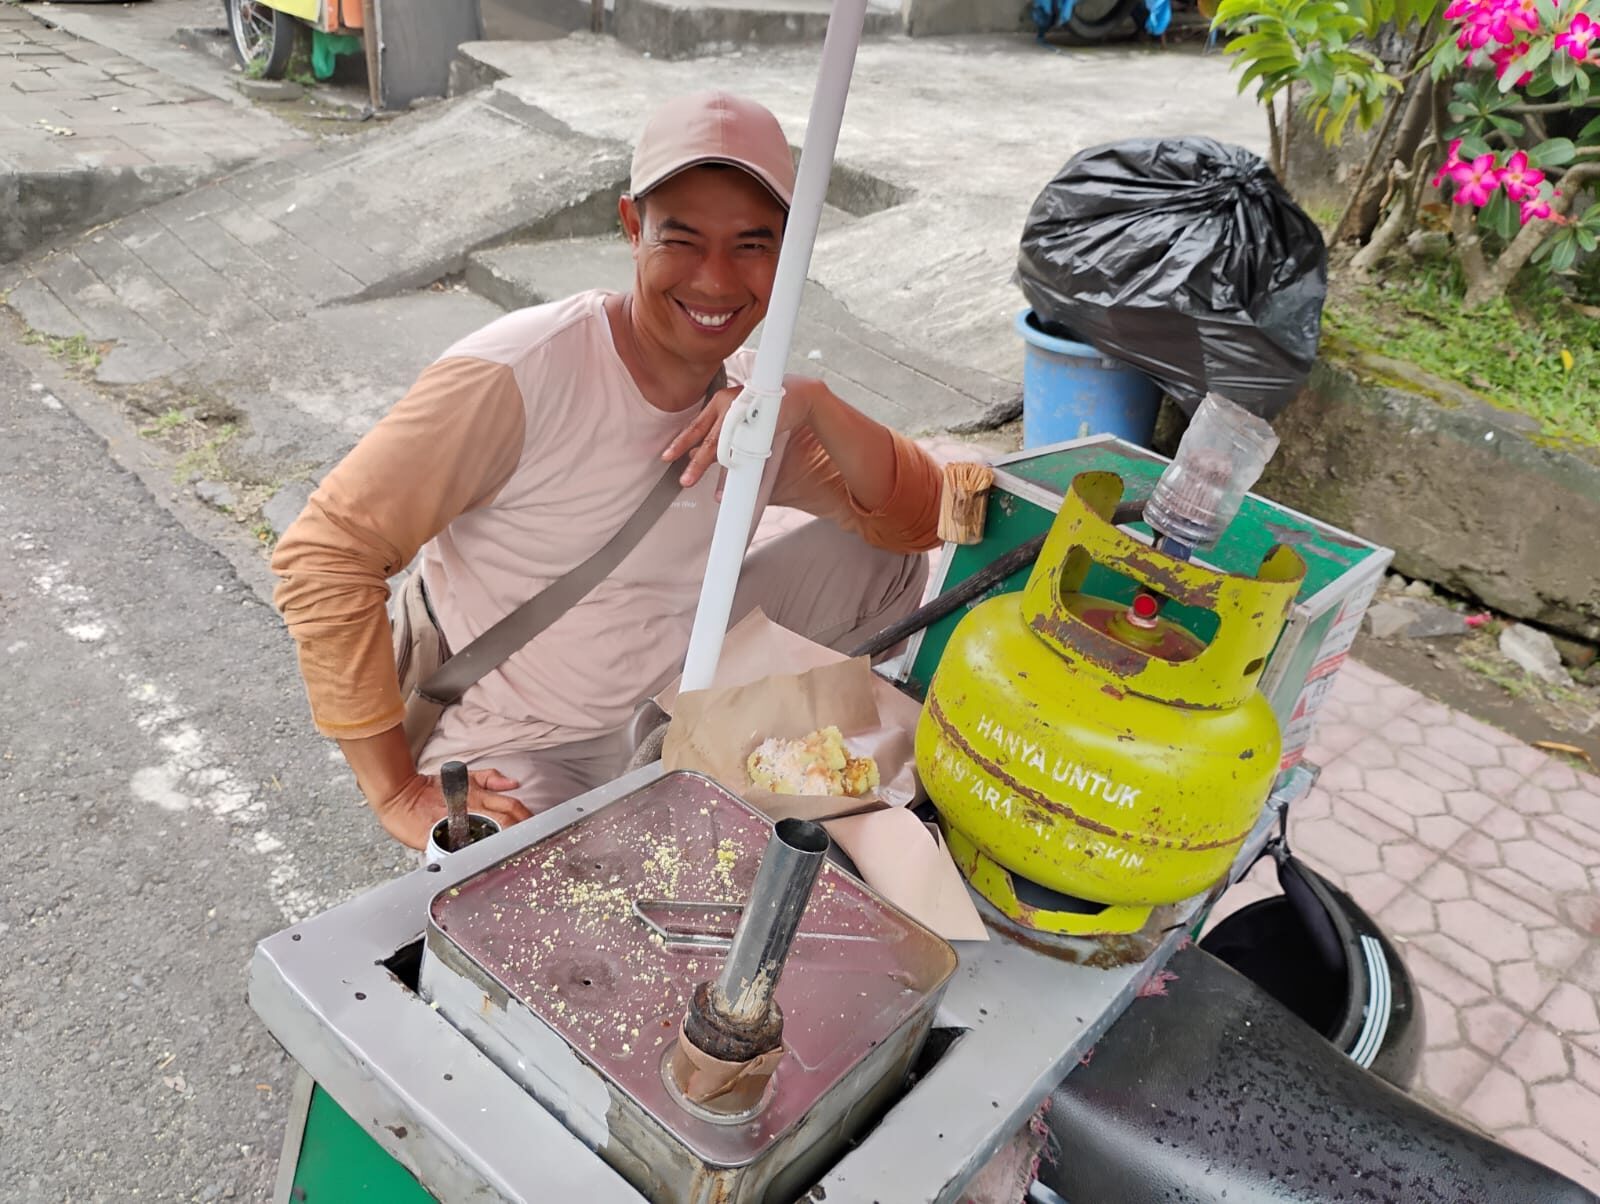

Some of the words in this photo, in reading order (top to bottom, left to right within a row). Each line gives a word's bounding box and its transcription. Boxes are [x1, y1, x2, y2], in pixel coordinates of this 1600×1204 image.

[934, 742, 1055, 840] ASARAA
[977, 714, 1045, 773] HANYA
[1052, 757, 1141, 809] UNTUK
